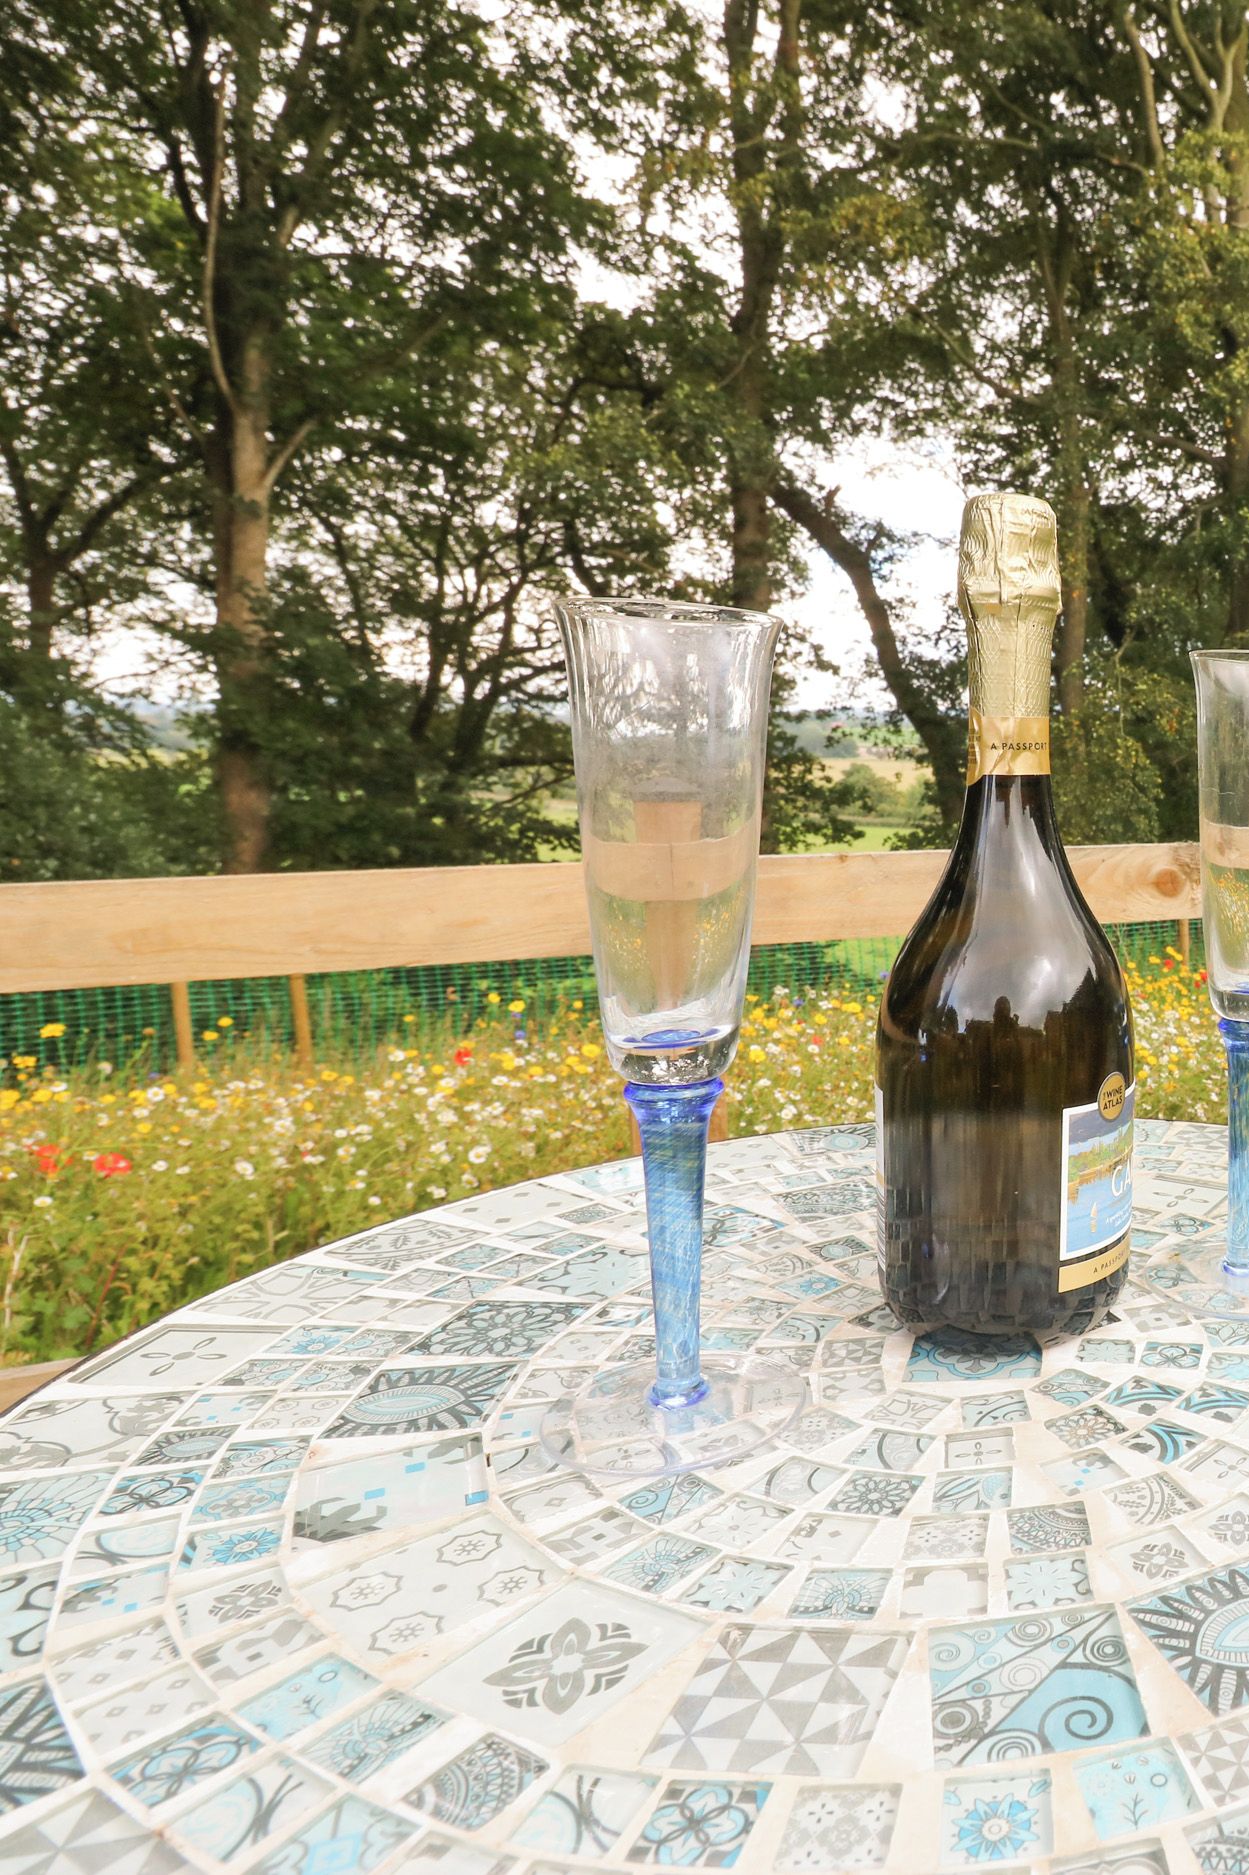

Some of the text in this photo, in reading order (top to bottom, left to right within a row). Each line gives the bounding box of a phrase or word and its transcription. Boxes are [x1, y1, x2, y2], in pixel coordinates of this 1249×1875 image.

[990, 742, 1047, 751] A PASSPORT
[1106, 1085, 1123, 1098] WINE
[1103, 1095, 1123, 1111] ATLAS
